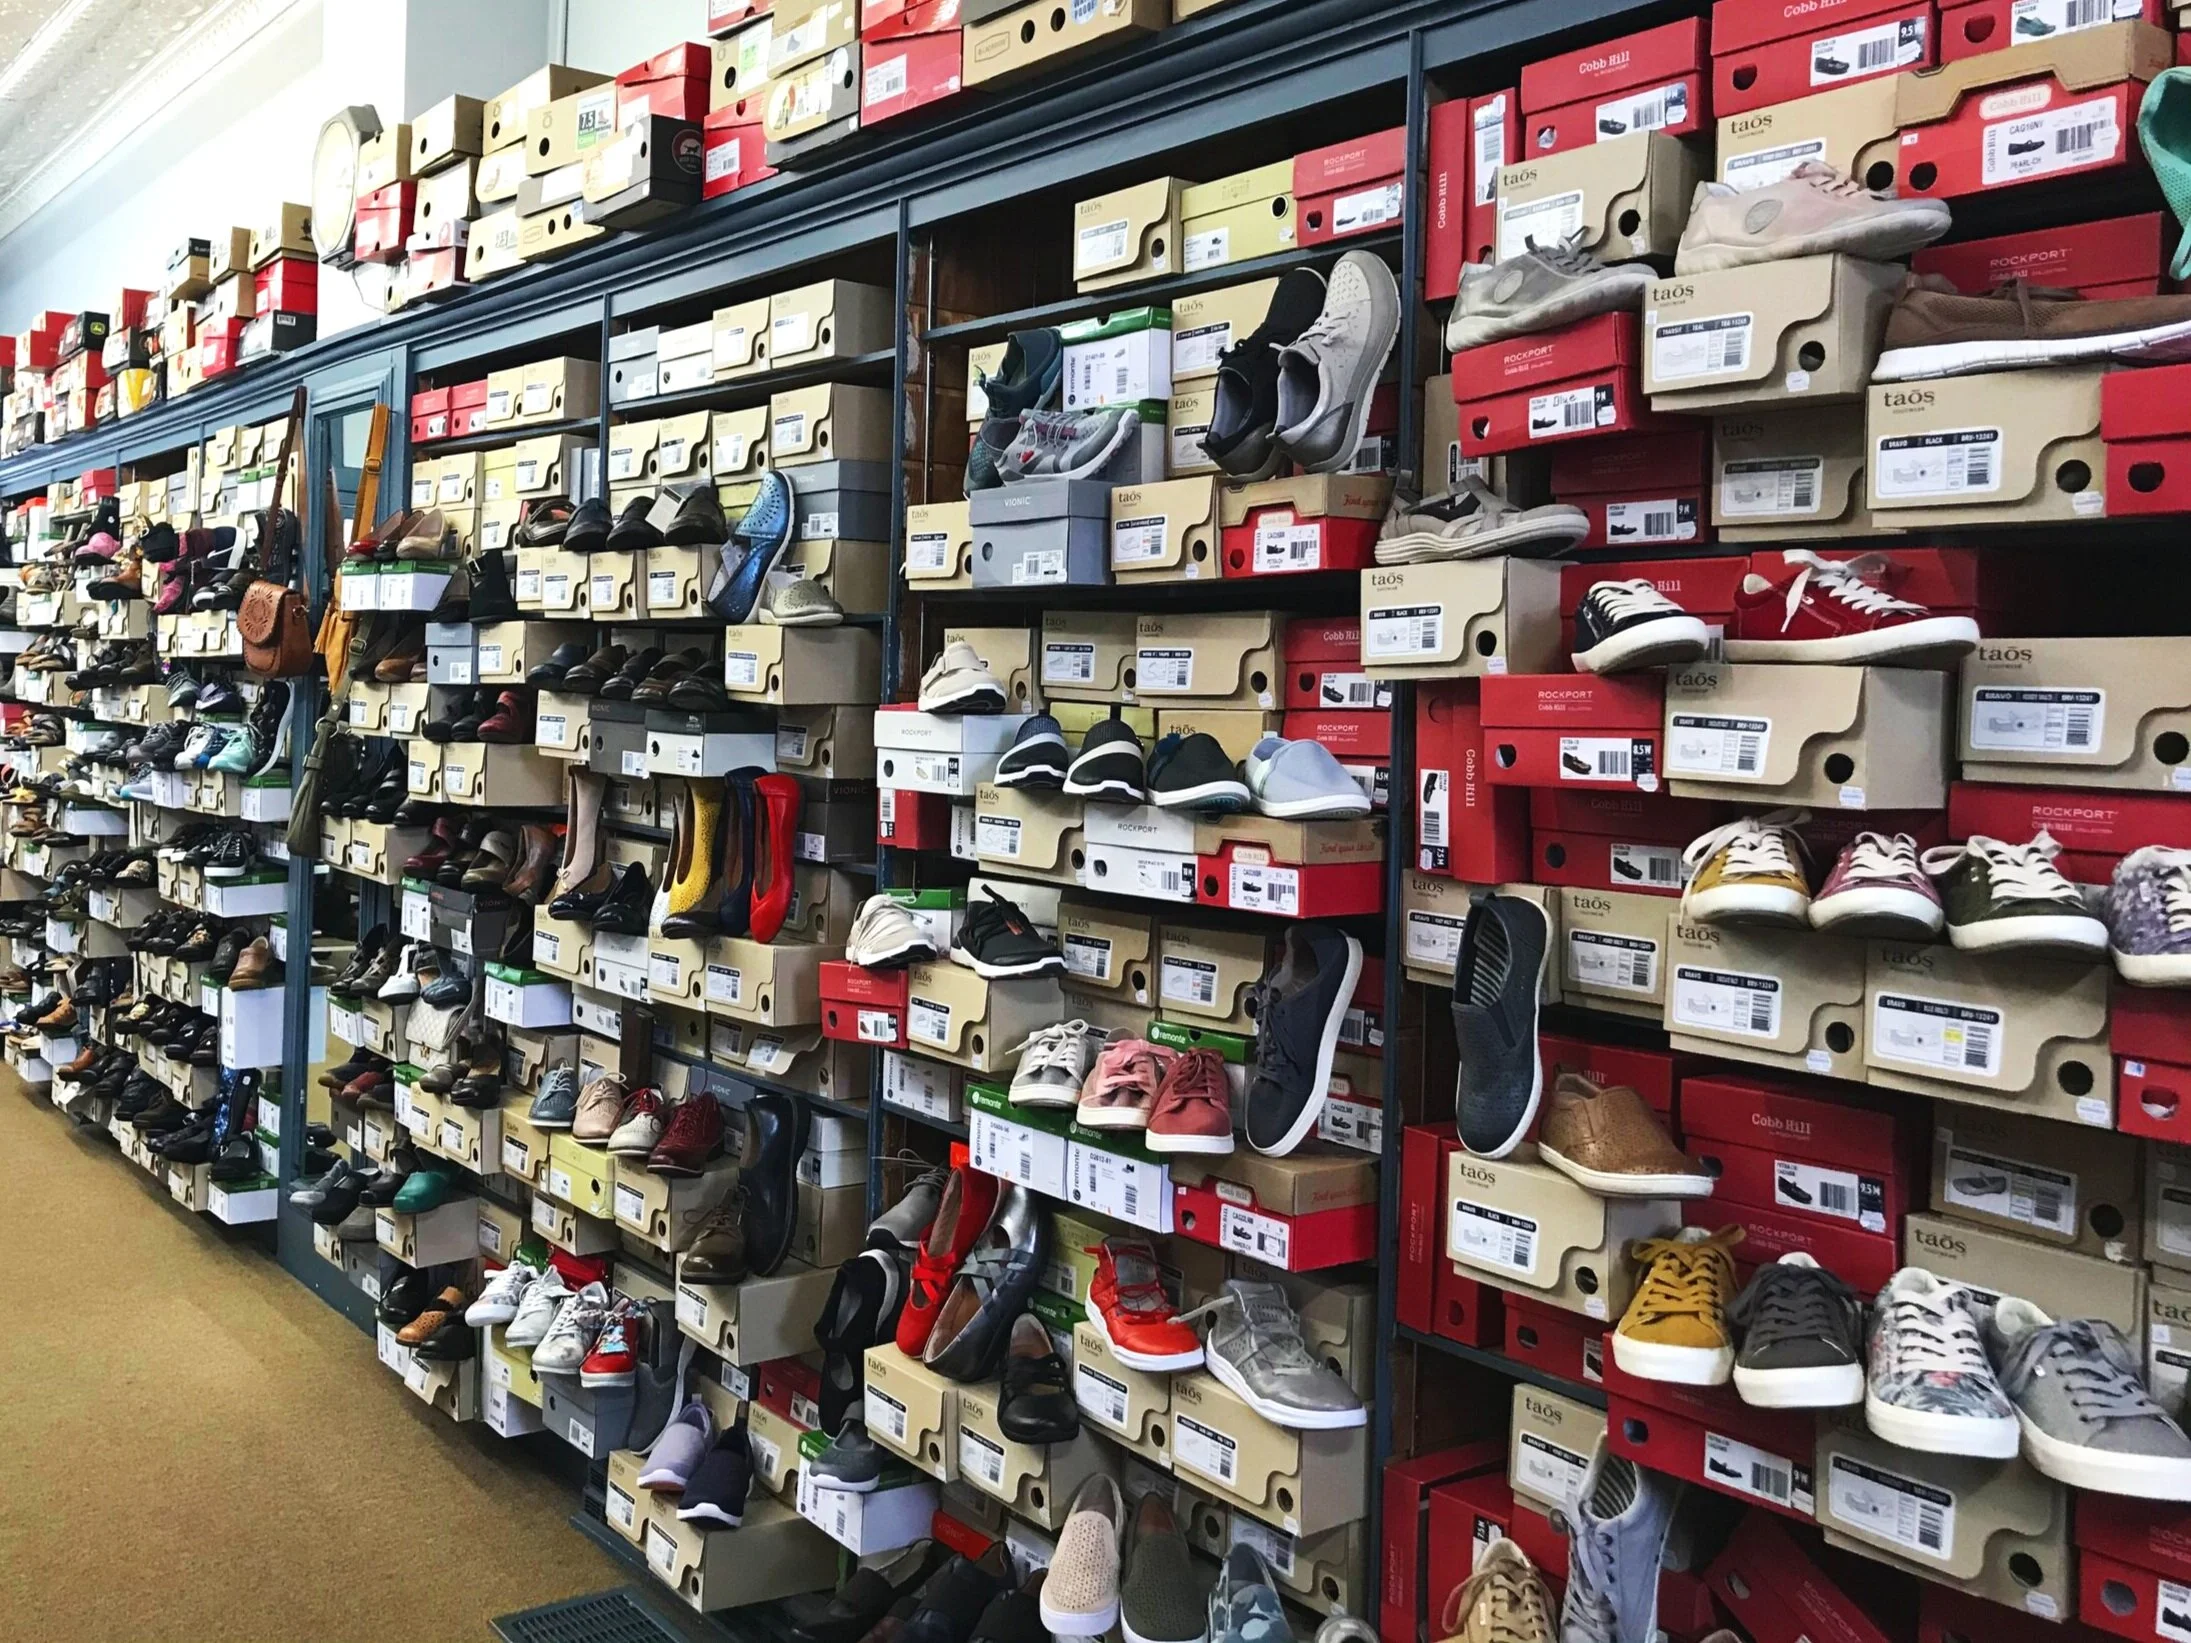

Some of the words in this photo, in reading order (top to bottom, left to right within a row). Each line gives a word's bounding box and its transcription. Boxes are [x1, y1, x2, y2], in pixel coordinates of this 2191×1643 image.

[1579, 58, 1606, 74] Cobb
[1608, 51, 1630, 65] Hill
[1323, 149, 1368, 166] ROCKPORT
[1437, 170, 1448, 198] Hill
[1437, 200, 1448, 230] Cobb
[1990, 248, 2068, 268] ROCKPORT
[1503, 345, 1555, 364] ROCKPORT
[1884, 388, 1936, 408] taōs
[1004, 496, 1033, 507] VIONIC
[1657, 580, 1682, 592] Hill
[1323, 630, 1344, 641] Cobb
[1345, 629, 1361, 640] Hil
[1978, 646, 2033, 662] taōs
[1675, 671, 1718, 687] taōs
[1538, 690, 1593, 700] ROCKPORT
[1317, 724, 1359, 733] ROCKPORT
[1464, 748, 1476, 774] Cobb
[1464, 776, 1476, 808] Hill
[2032, 806, 2114, 819] ROCKPORT
[1117, 823, 1158, 833] ROCKPORT
[1676, 923, 1721, 943] taōs
[1158, 1031, 1187, 1045] remonte
[978, 1095, 1003, 1110] remonte
[1752, 1112, 1783, 1129] Cobb
[1785, 1119, 1812, 1135] Hill
[1408, 1200, 1419, 1262] ROCKPORT
[1748, 1223, 1812, 1247] ROCKPORT
[1914, 1228, 1968, 1253] taōs
